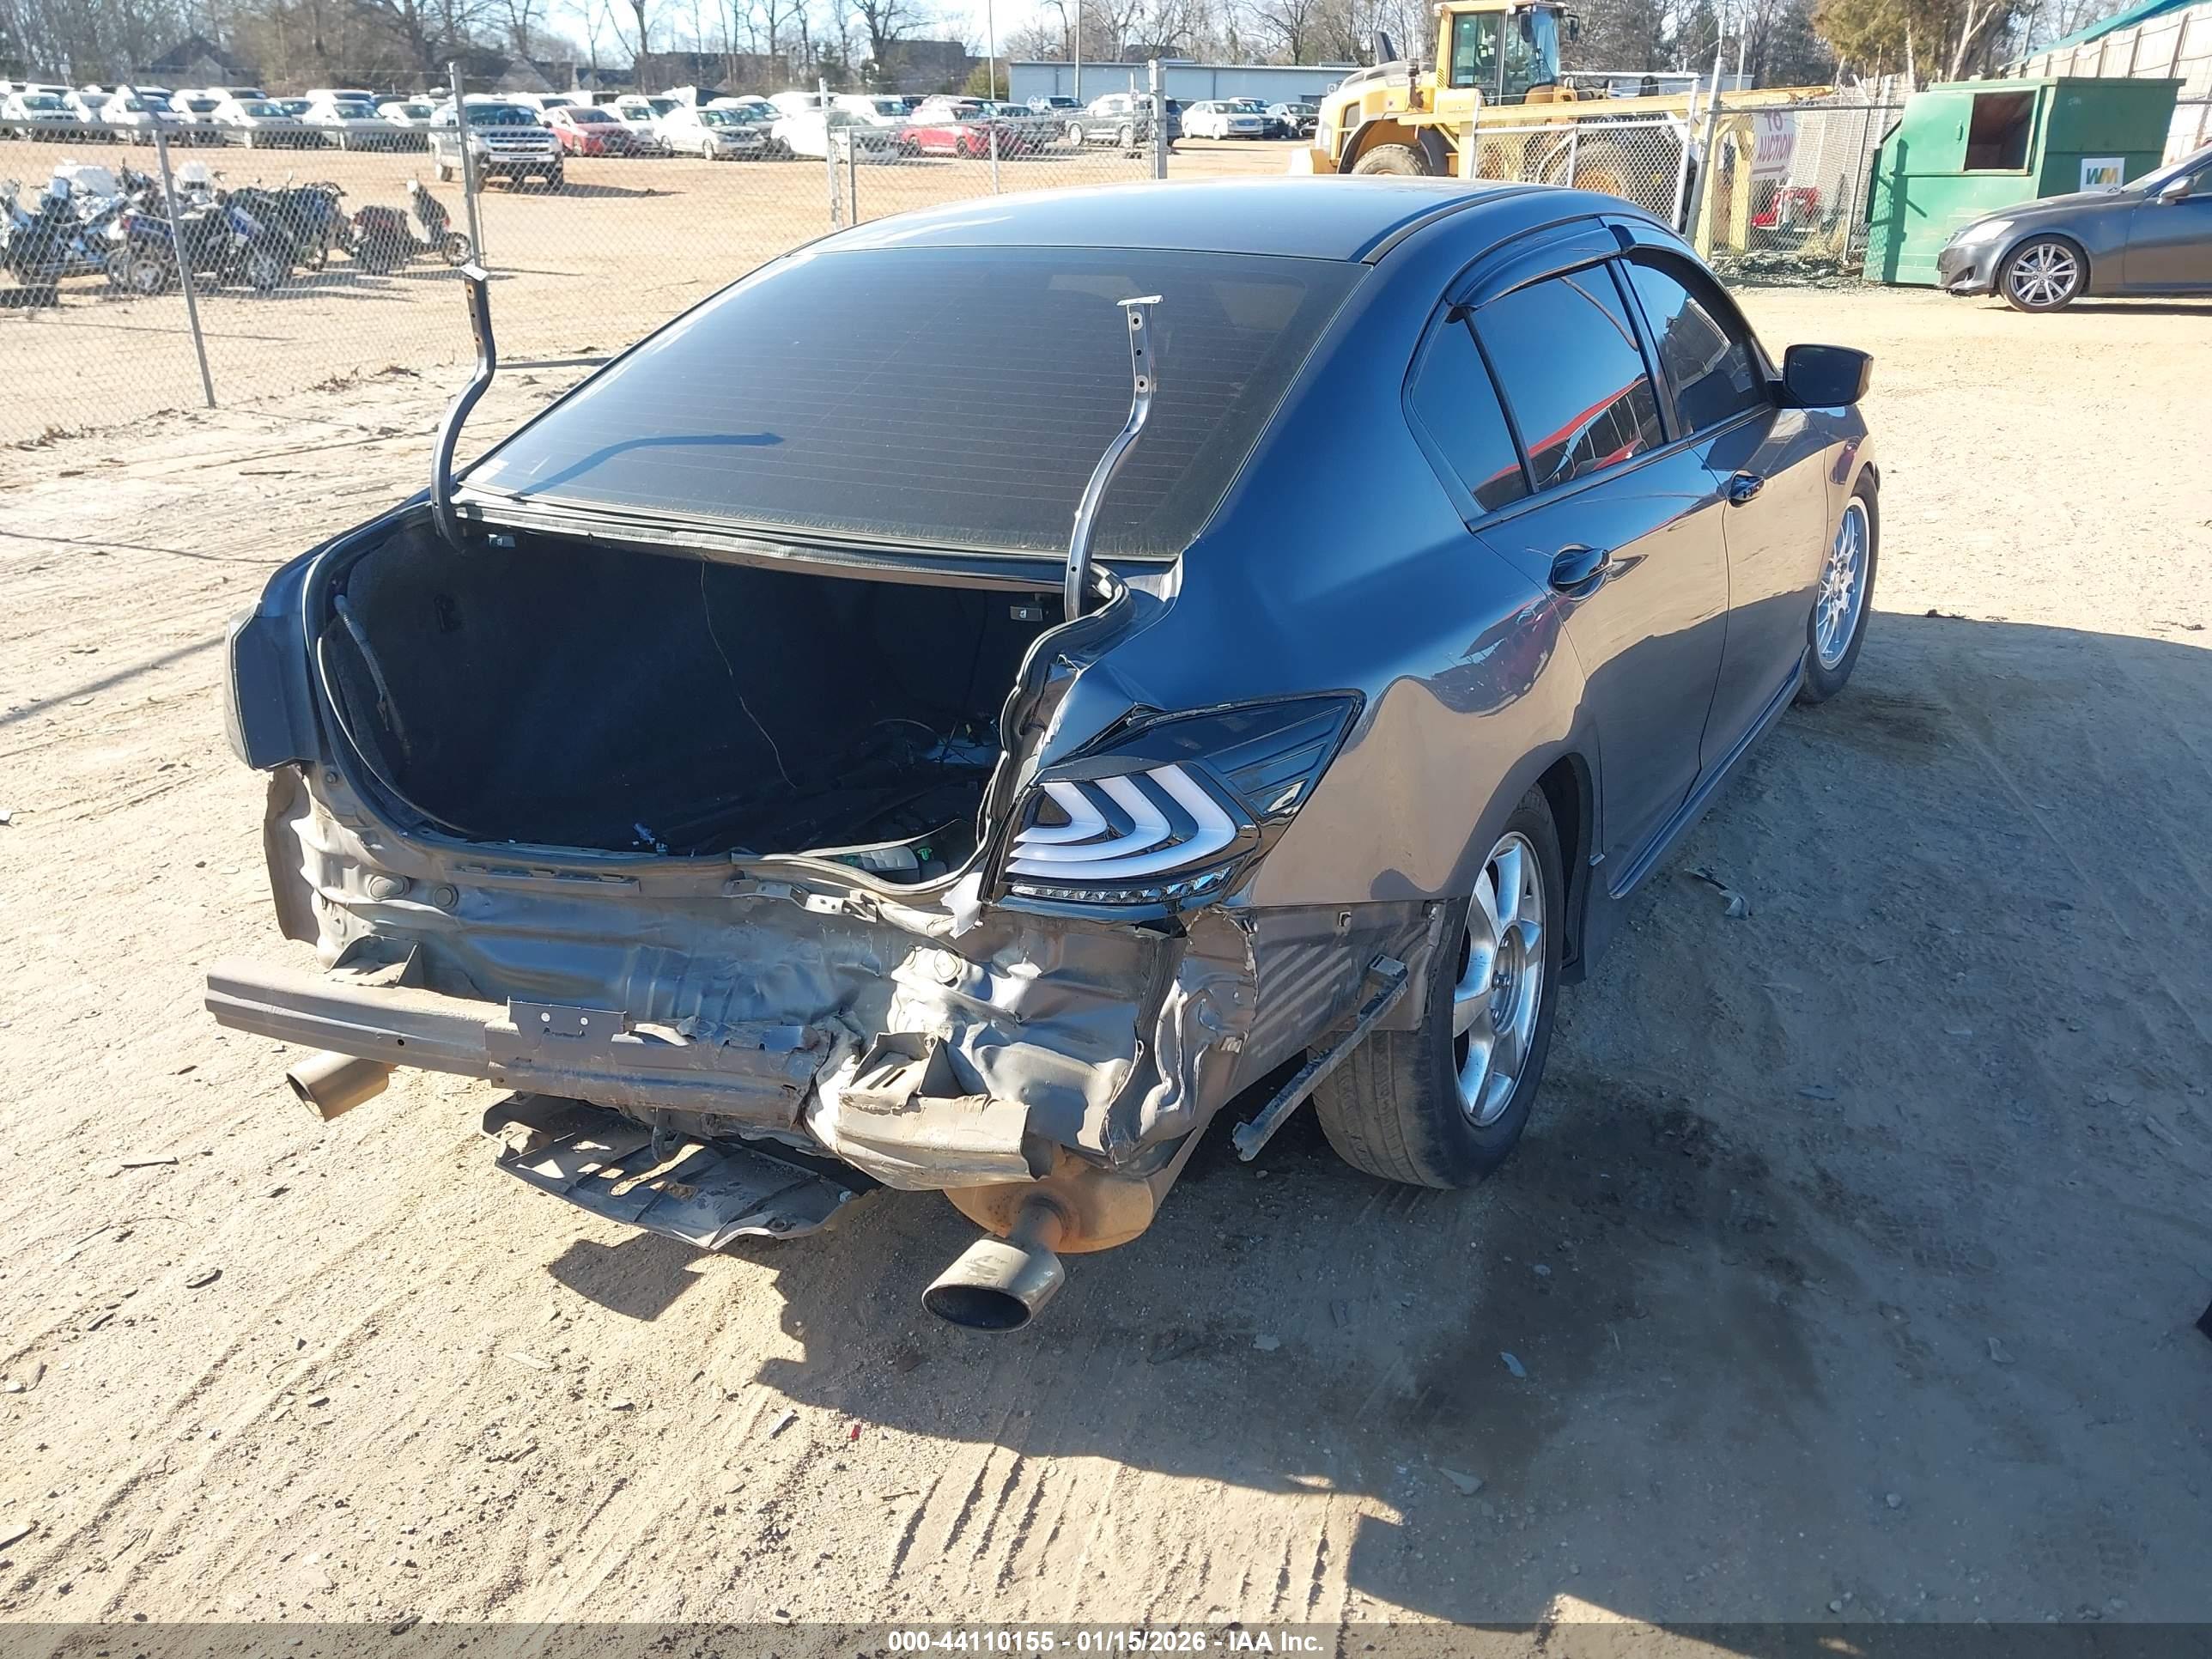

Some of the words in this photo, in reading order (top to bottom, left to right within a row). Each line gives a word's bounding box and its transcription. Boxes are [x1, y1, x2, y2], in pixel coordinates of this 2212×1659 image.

[1765, 109, 1784, 131] TO
[1757, 133, 1794, 162] AUCTION
[2086, 167, 2119, 185] WM
